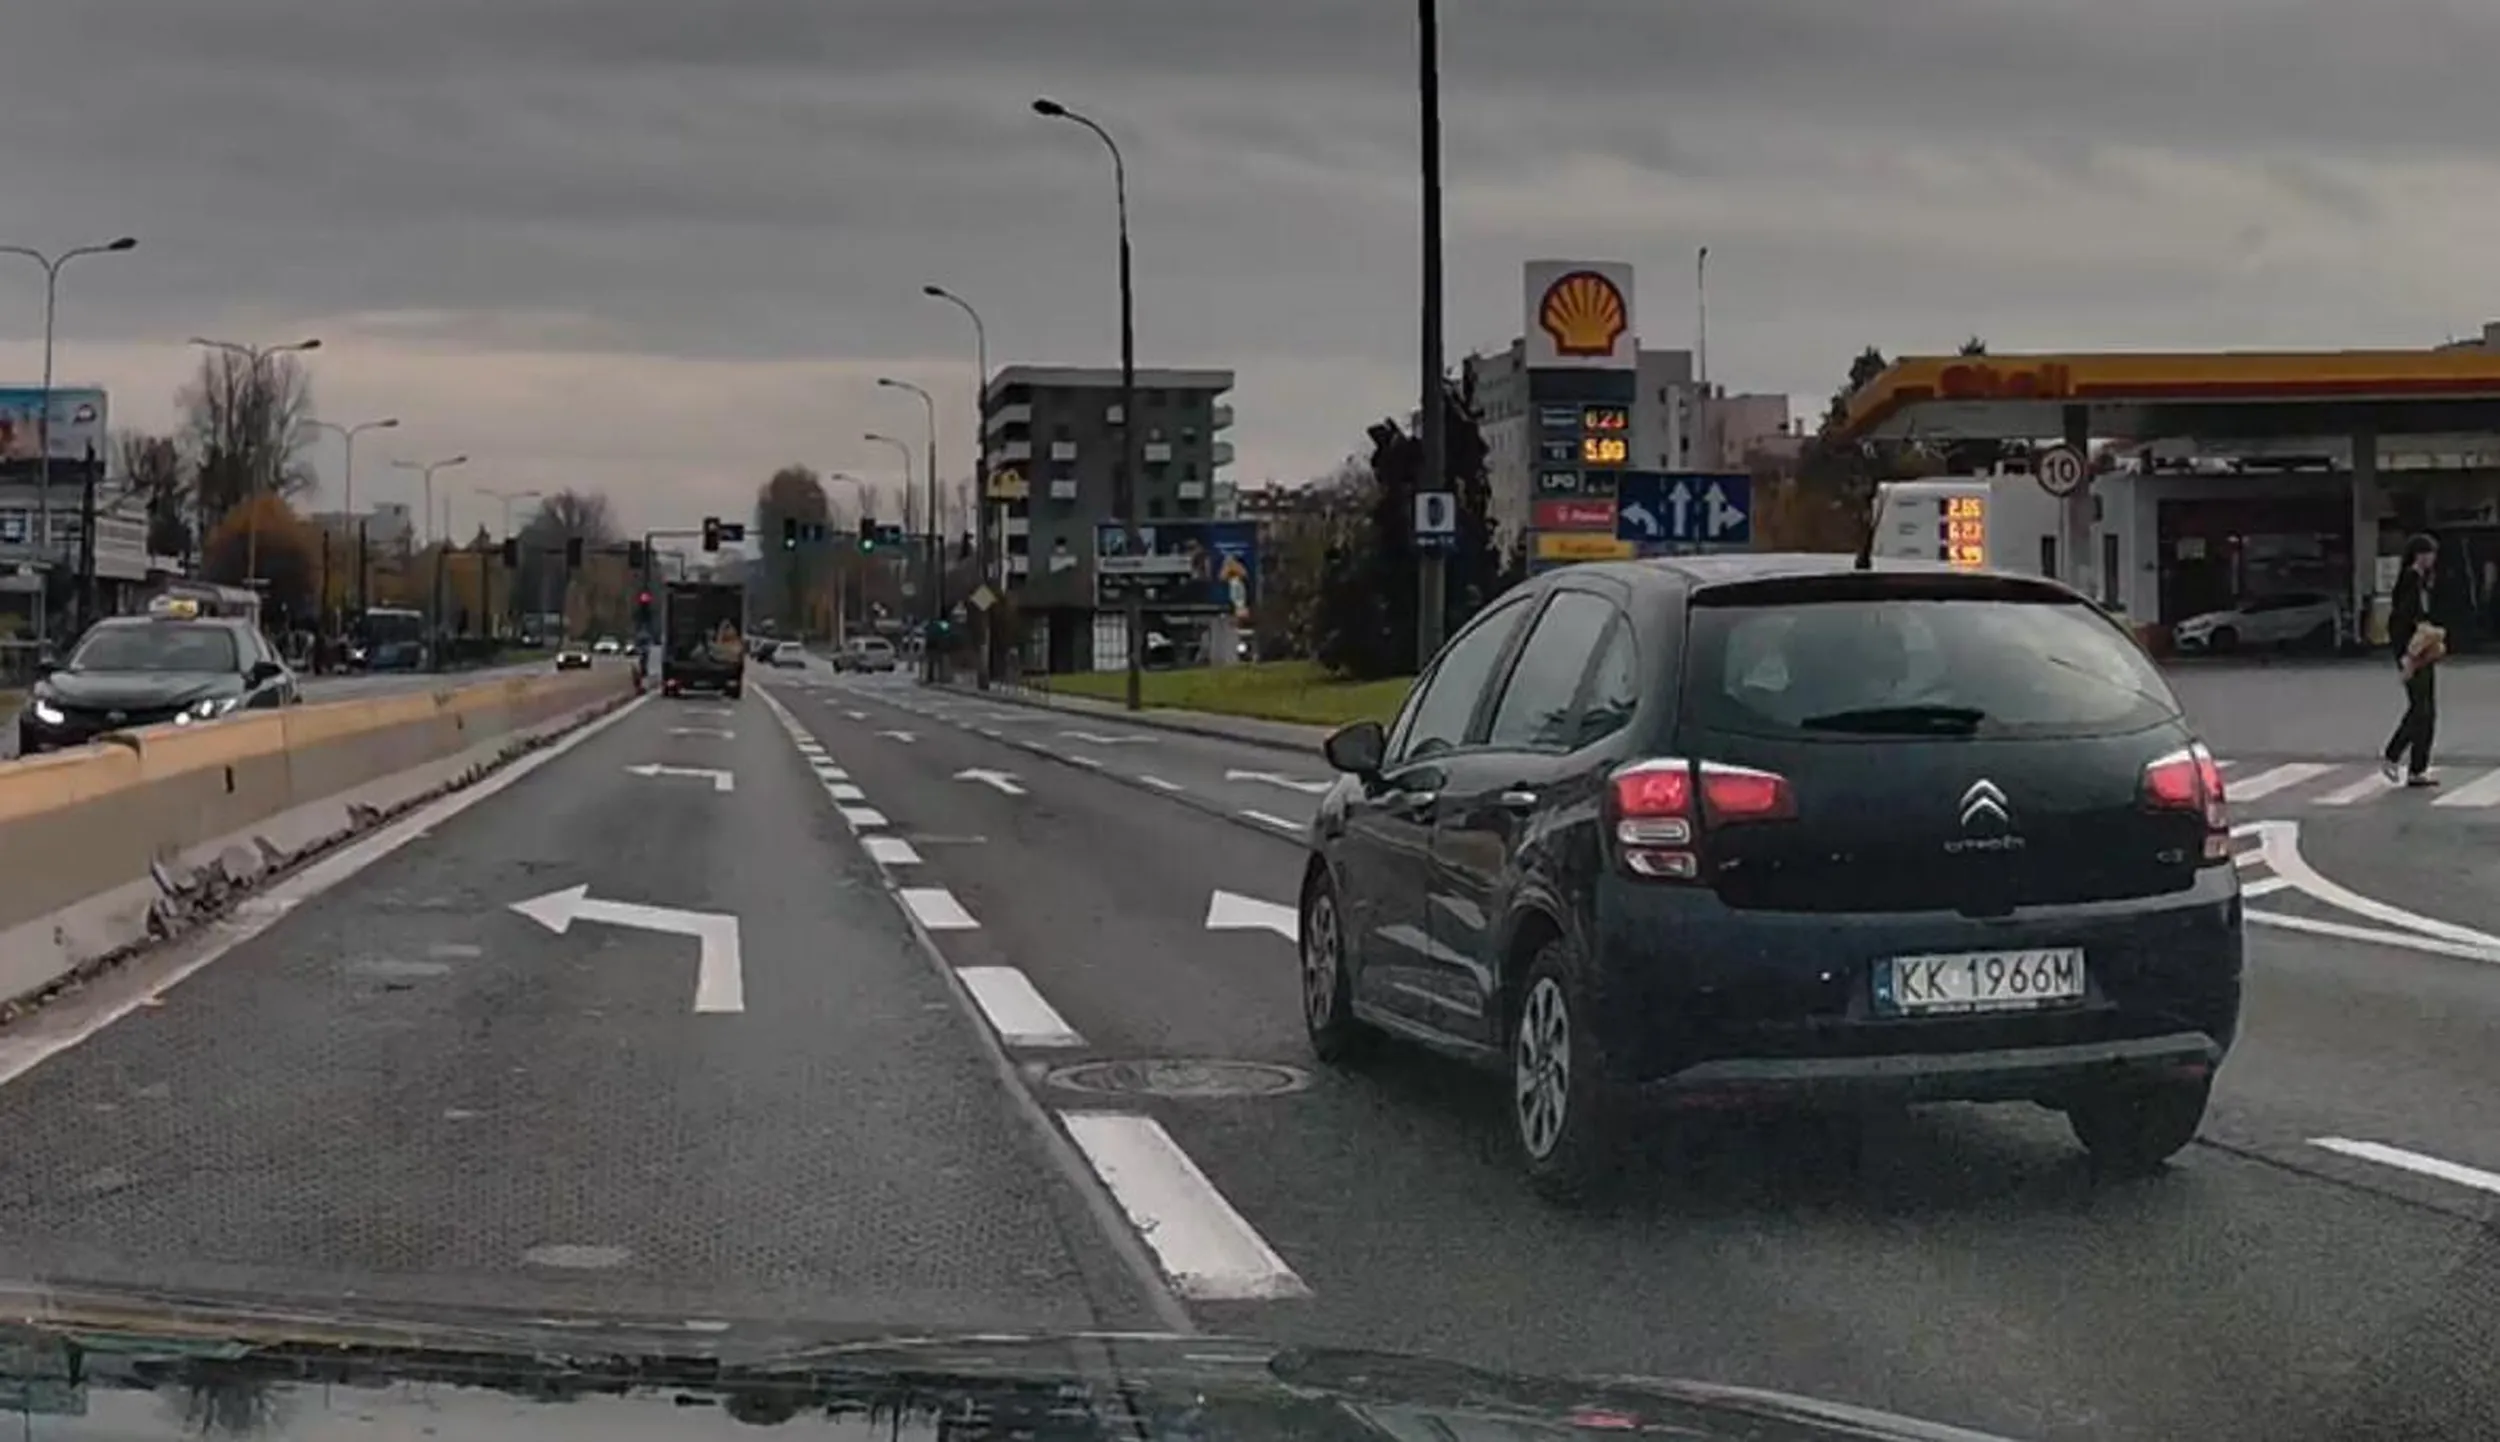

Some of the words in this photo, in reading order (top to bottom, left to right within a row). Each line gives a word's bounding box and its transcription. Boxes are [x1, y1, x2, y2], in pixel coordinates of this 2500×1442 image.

[2044, 456, 2076, 485] 10
[1901, 959, 1949, 1001] KK
[1966, 953, 2076, 998] 1966M
